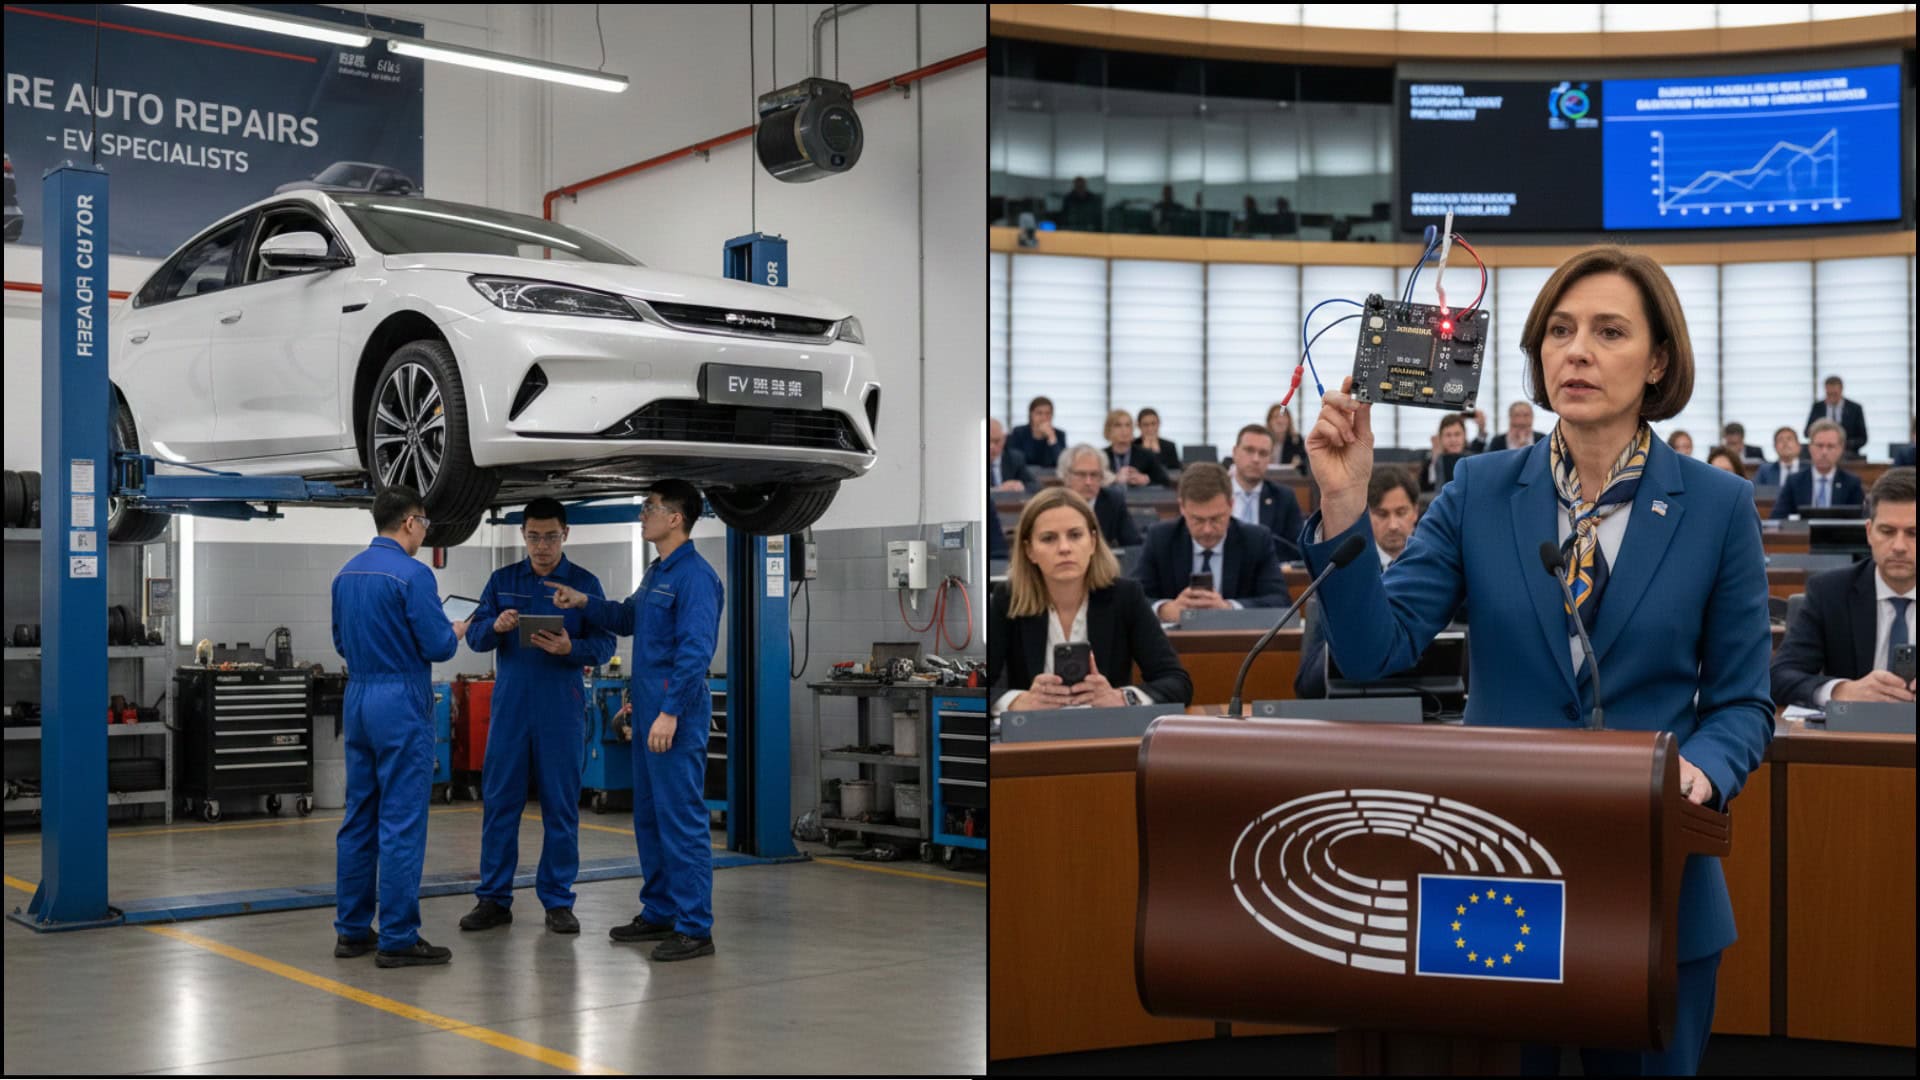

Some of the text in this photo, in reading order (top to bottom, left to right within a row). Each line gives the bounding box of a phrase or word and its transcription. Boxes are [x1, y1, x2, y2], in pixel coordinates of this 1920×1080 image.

[7, 73, 319, 147] RE AUTO REPAIRS
[63, 128, 94, 152] EV
[101, 133, 249, 173] SPECIALISTS
[728, 376, 749, 392] EV
